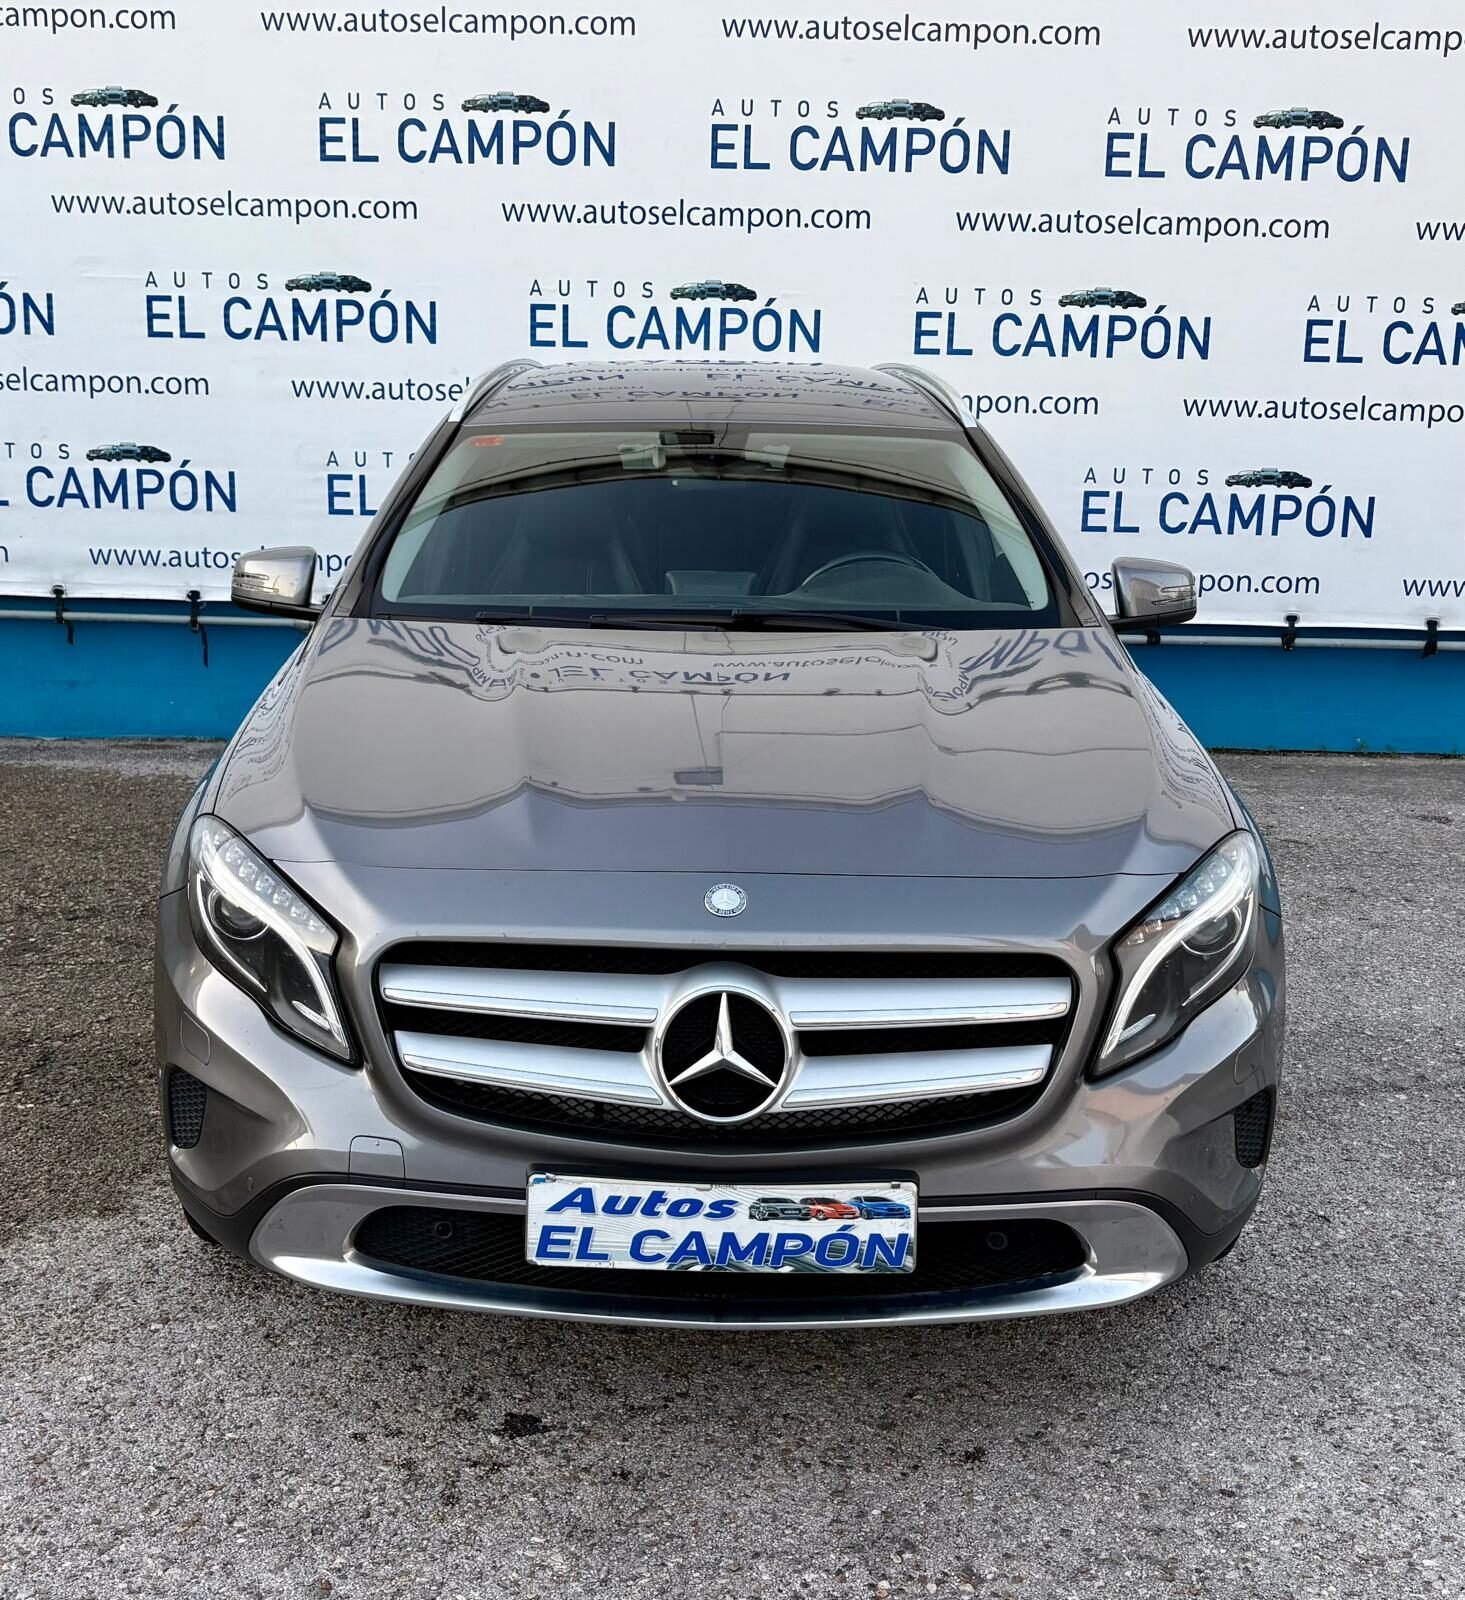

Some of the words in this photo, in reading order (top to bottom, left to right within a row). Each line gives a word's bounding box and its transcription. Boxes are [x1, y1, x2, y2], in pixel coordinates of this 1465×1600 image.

[260, 5, 636, 41] www.autoselcampon.com
[721, 13, 1101, 50] www.autoselcampon.com
[1187, 21, 1465, 58] www.autoselcamp
[318, 92, 445, 111] AUTOS
[711, 98, 839, 119] AUTOS
[1107, 106, 1237, 127] AUTOS
[8, 104, 225, 161] CAMPÓN
[319, 116, 380, 163] EL
[397, 110, 616, 167] CAMPÓN
[710, 123, 771, 170] EL
[789, 117, 1011, 175] CAMPÓN
[1104, 131, 1166, 179] EL
[1185, 125, 1410, 183] CAMPÓN
[50, 189, 418, 225] www.autoselcampon.com
[501, 198, 871, 234] www.autoselcampon.com
[955, 207, 1330, 244] www.autoselcampon.com
[145, 271, 269, 290] AUTOS
[529, 279, 654, 299] AUTOS
[915, 287, 1042, 306] AUTOS
[145, 294, 206, 339] EL
[223, 289, 437, 345] CAMPÓN
[1306, 294, 1435, 315] AUTOS
[529, 303, 589, 348] EL
[606, 297, 821, 353] CAMPÓN
[913, 311, 973, 356] EL
[992, 305, 1212, 361] CAMPÓN
[1303, 318, 1364, 364] EL
[326, 450, 413, 468] AUT
[1083, 467, 1209, 486] AUTOS
[26, 460, 237, 513] CAMPÓN
[1080, 490, 1140, 534] EL
[1158, 485, 1376, 539] CAMPÓN
[545, 1186, 739, 1219] Autos
[534, 1225, 609, 1261] EL
[629, 1224, 910, 1267] CAMPÓN
